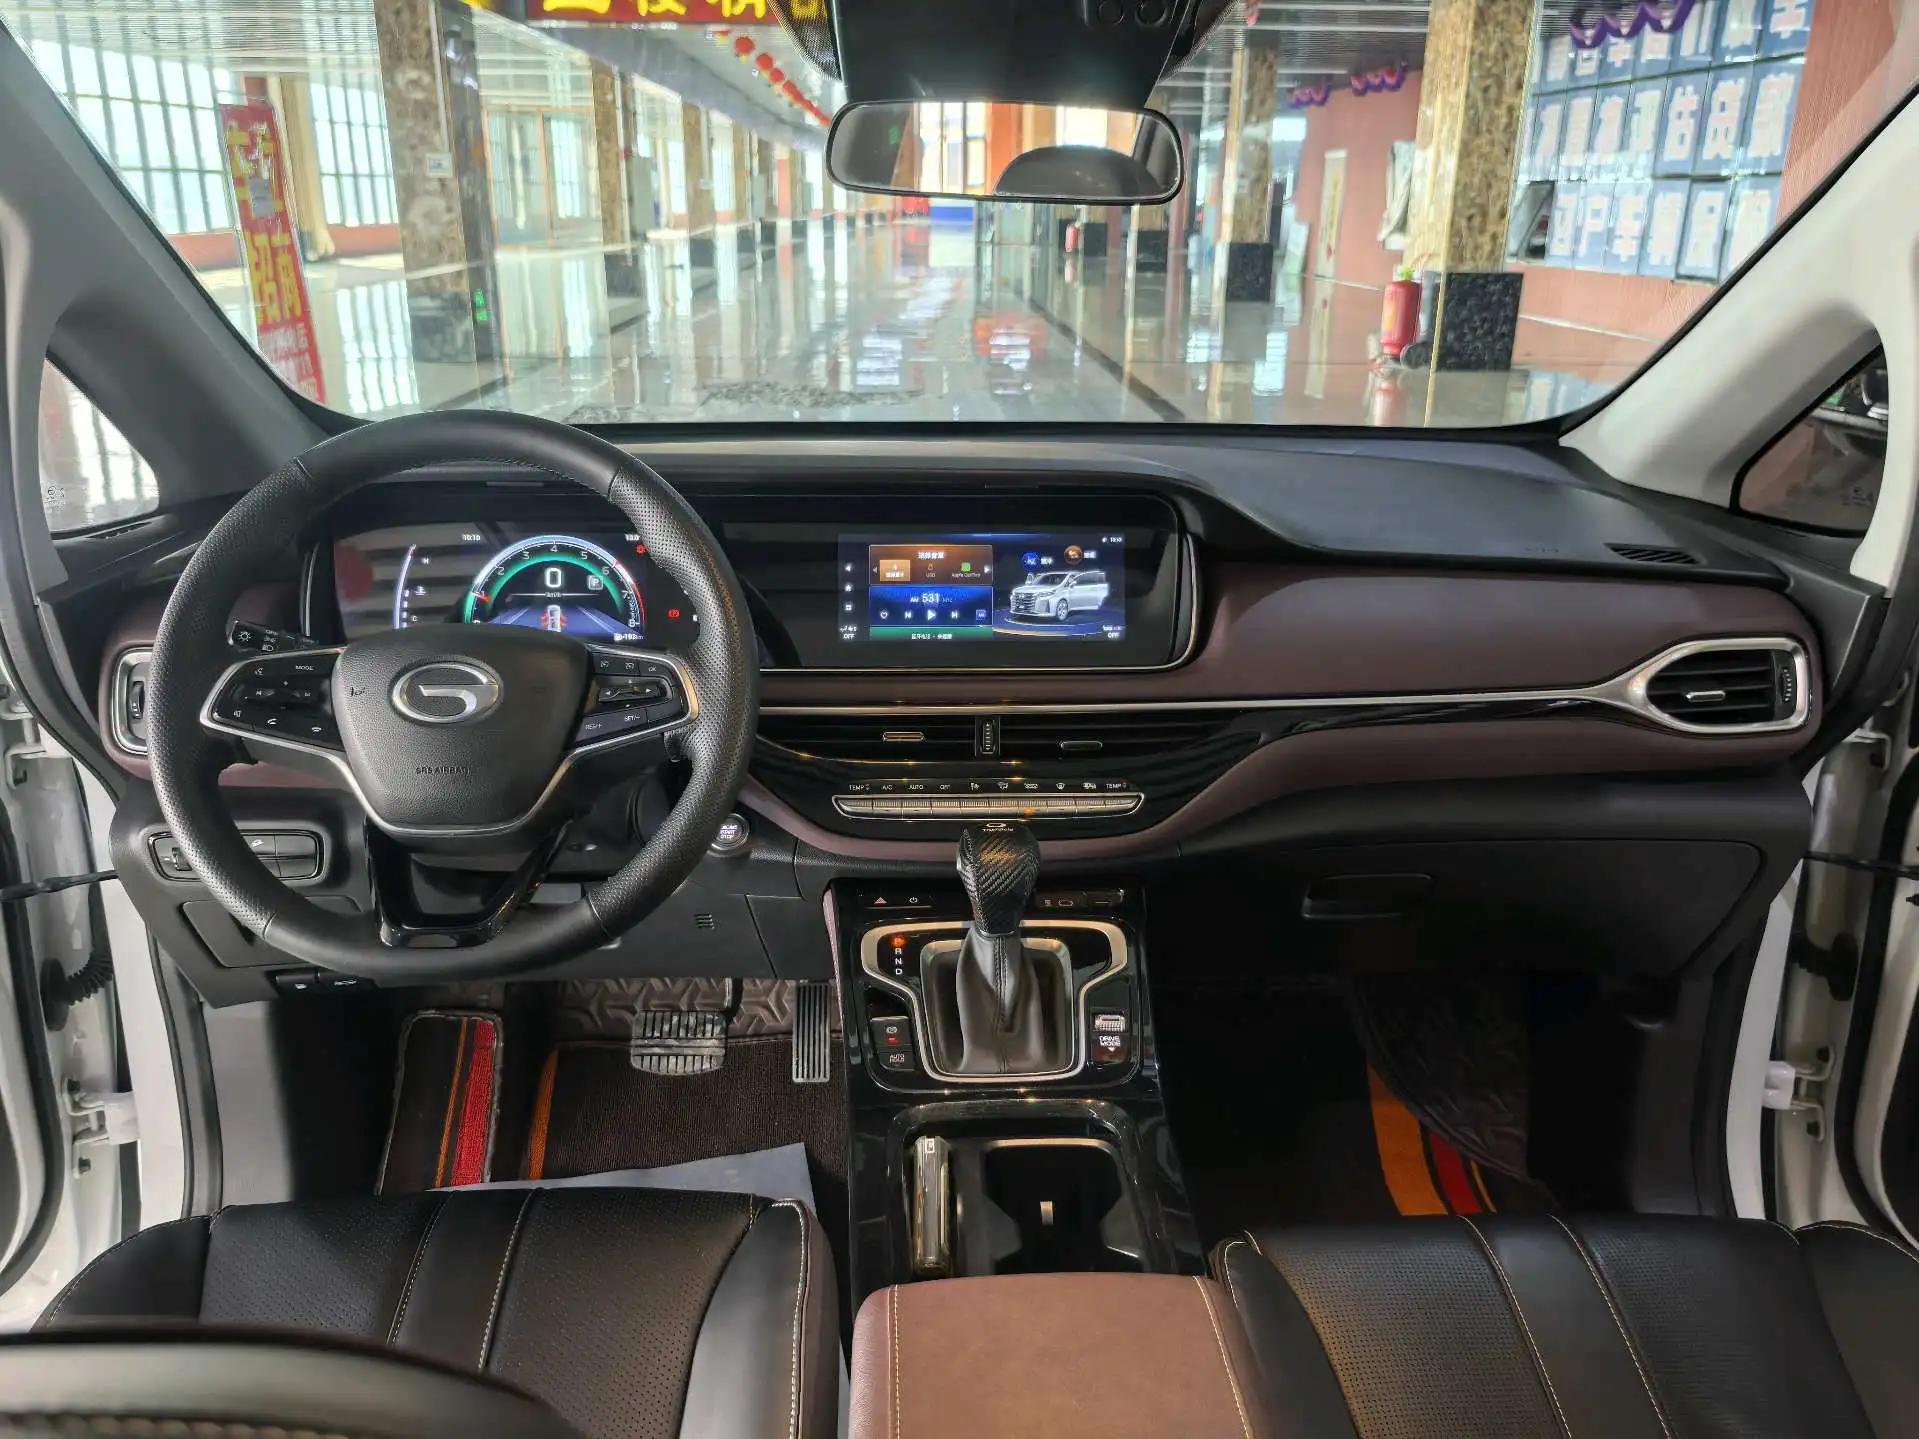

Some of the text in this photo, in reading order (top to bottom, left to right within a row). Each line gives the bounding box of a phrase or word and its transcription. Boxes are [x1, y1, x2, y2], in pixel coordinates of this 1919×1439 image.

[497, 567, 505, 575] 2
[602, 566, 610, 575] 6
[545, 567, 562, 588] 0
[622, 590, 629, 599] 7
[921, 593, 940, 603] 531
